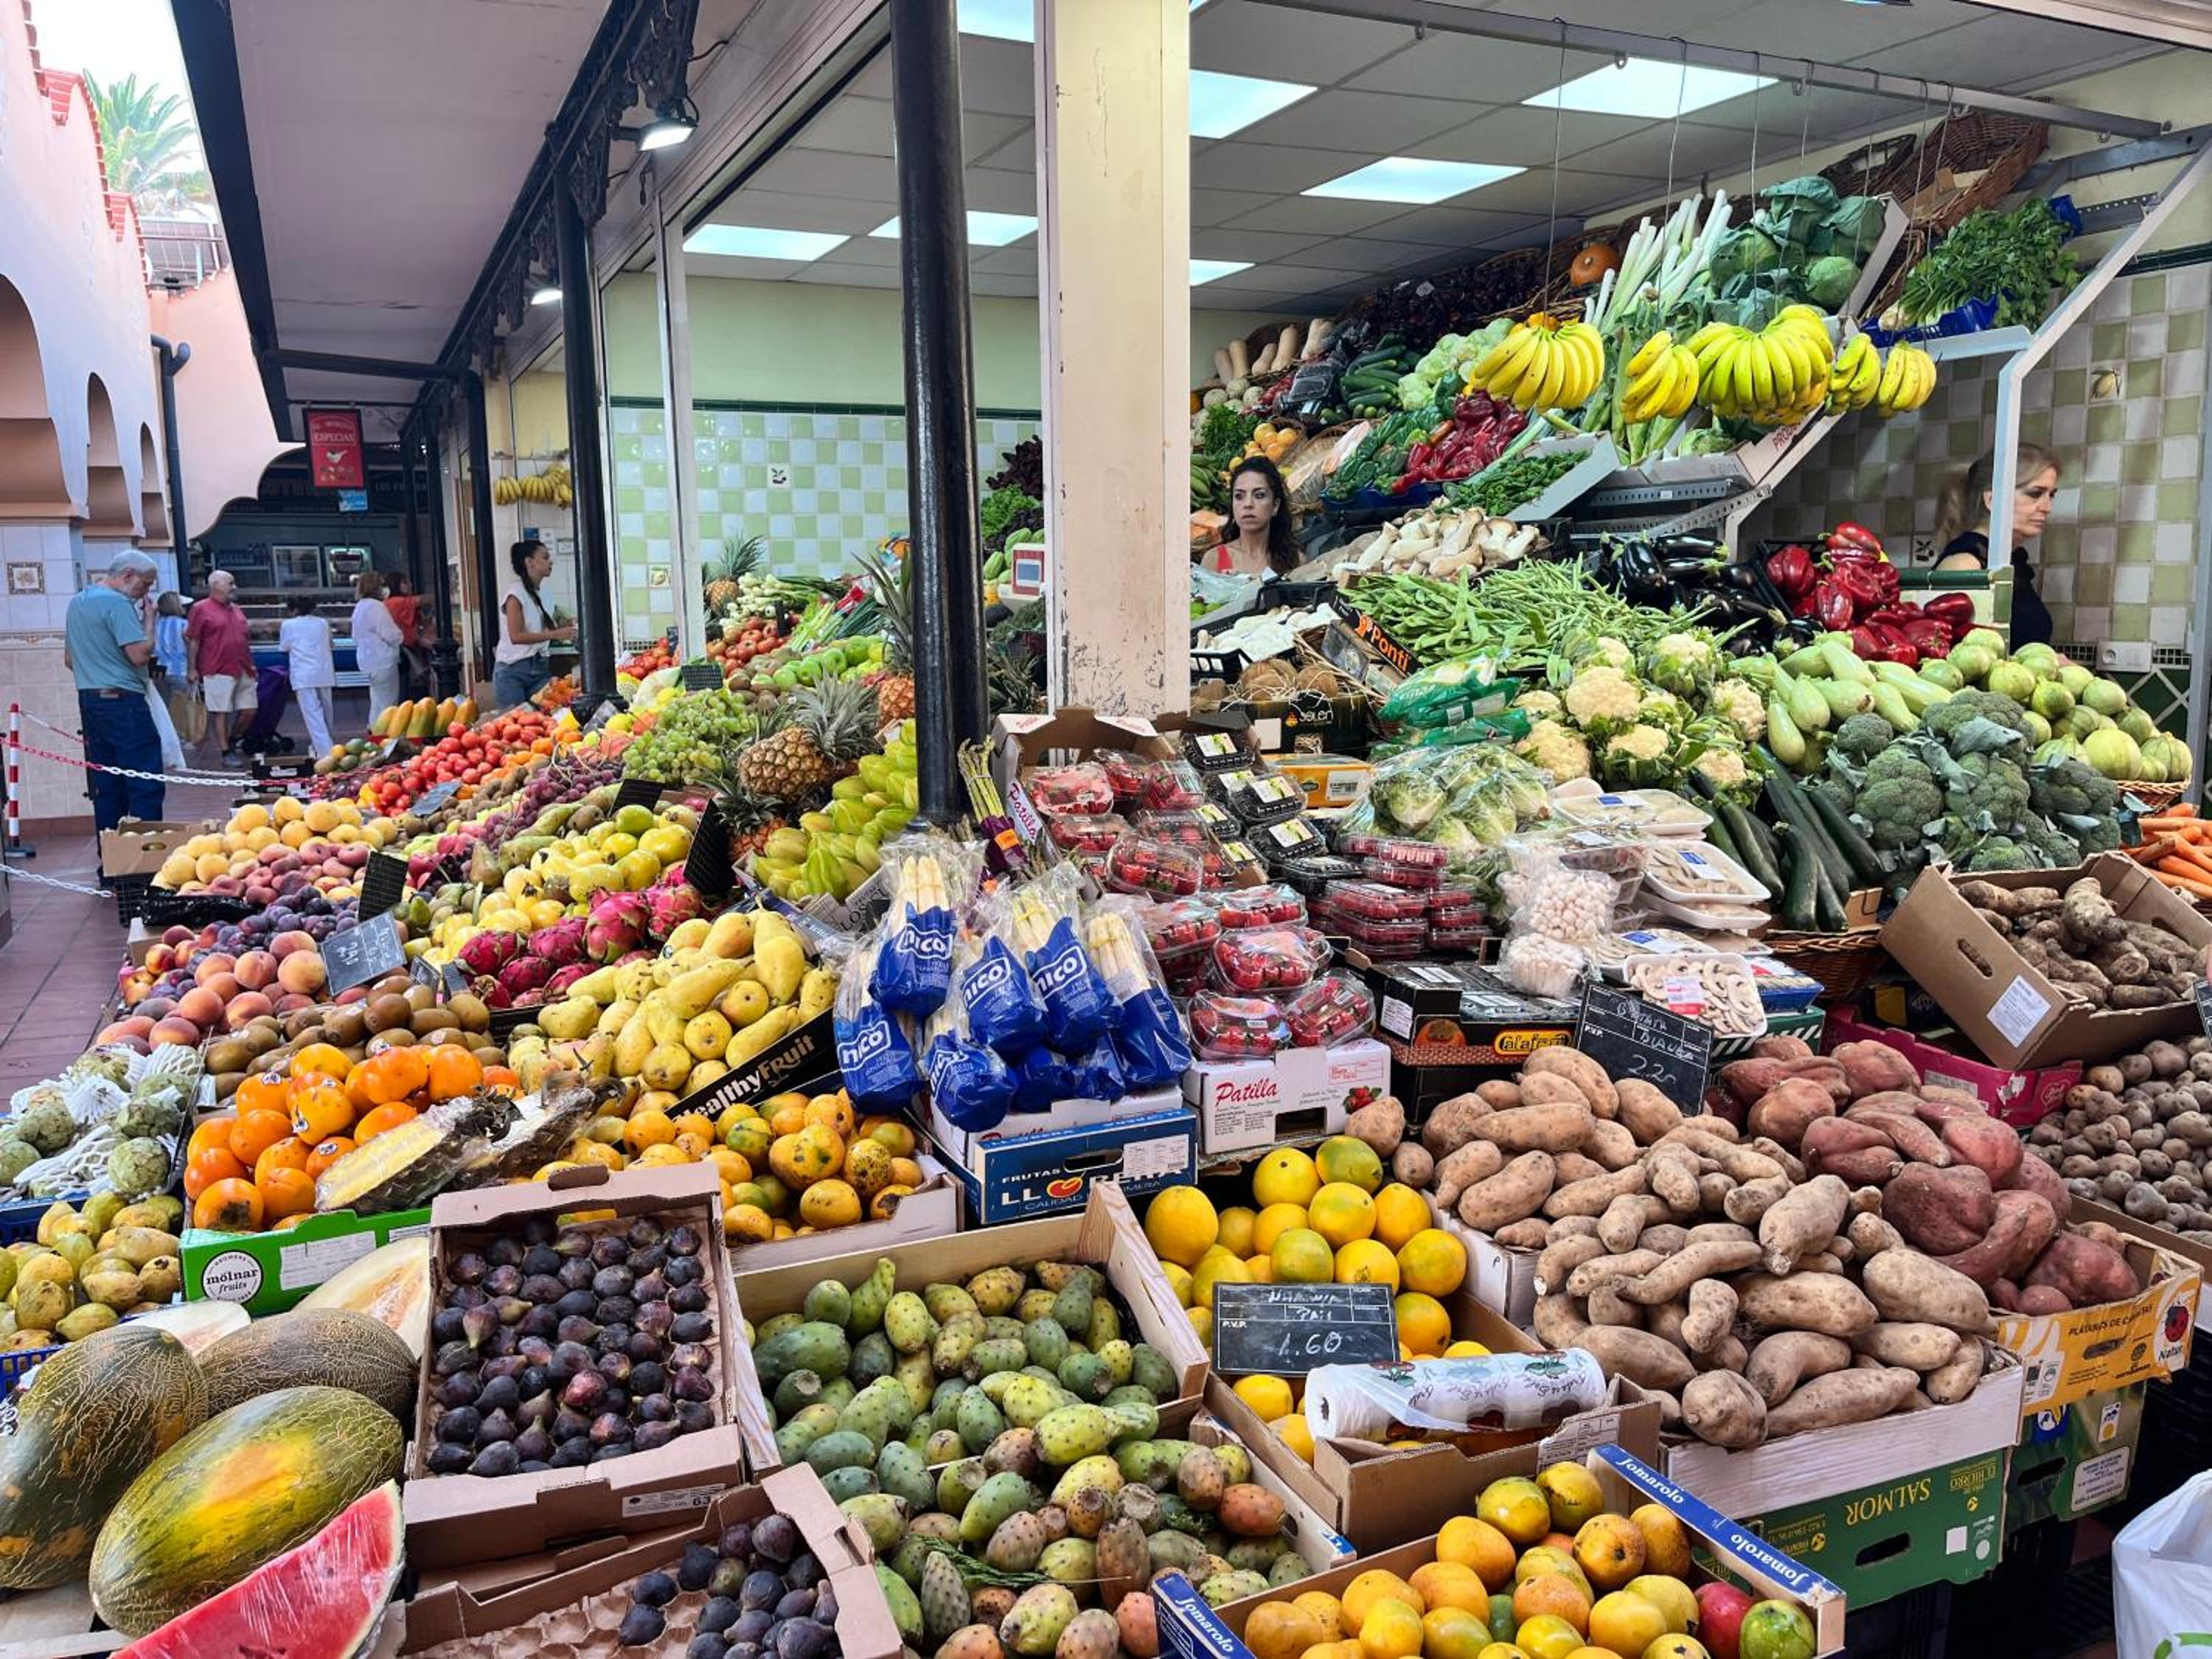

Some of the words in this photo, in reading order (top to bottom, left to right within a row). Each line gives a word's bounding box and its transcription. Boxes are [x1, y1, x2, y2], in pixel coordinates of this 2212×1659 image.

[1371, 625, 1410, 672] Ponti
[1007, 782, 1038, 840] Patilla
[904, 930, 947, 952] nico
[841, 1030, 884, 1065] nico
[1215, 1077, 1279, 1107] Patilla
[1002, 1168, 1061, 1184] FRUTAS
[1023, 1194, 1083, 1211] CALIDAD
[220, 1279, 247, 1294] fruits
[1278, 1331, 1343, 1356] 1.60
[2158, 1344, 2184, 1361] Natur
[1615, 1458, 1685, 1504] Jomarolo
[1844, 1477, 1932, 1526] SALMOR
[1730, 1534, 1810, 1586] Jomarolo
[1175, 1597, 1234, 1652] Jomarolo
